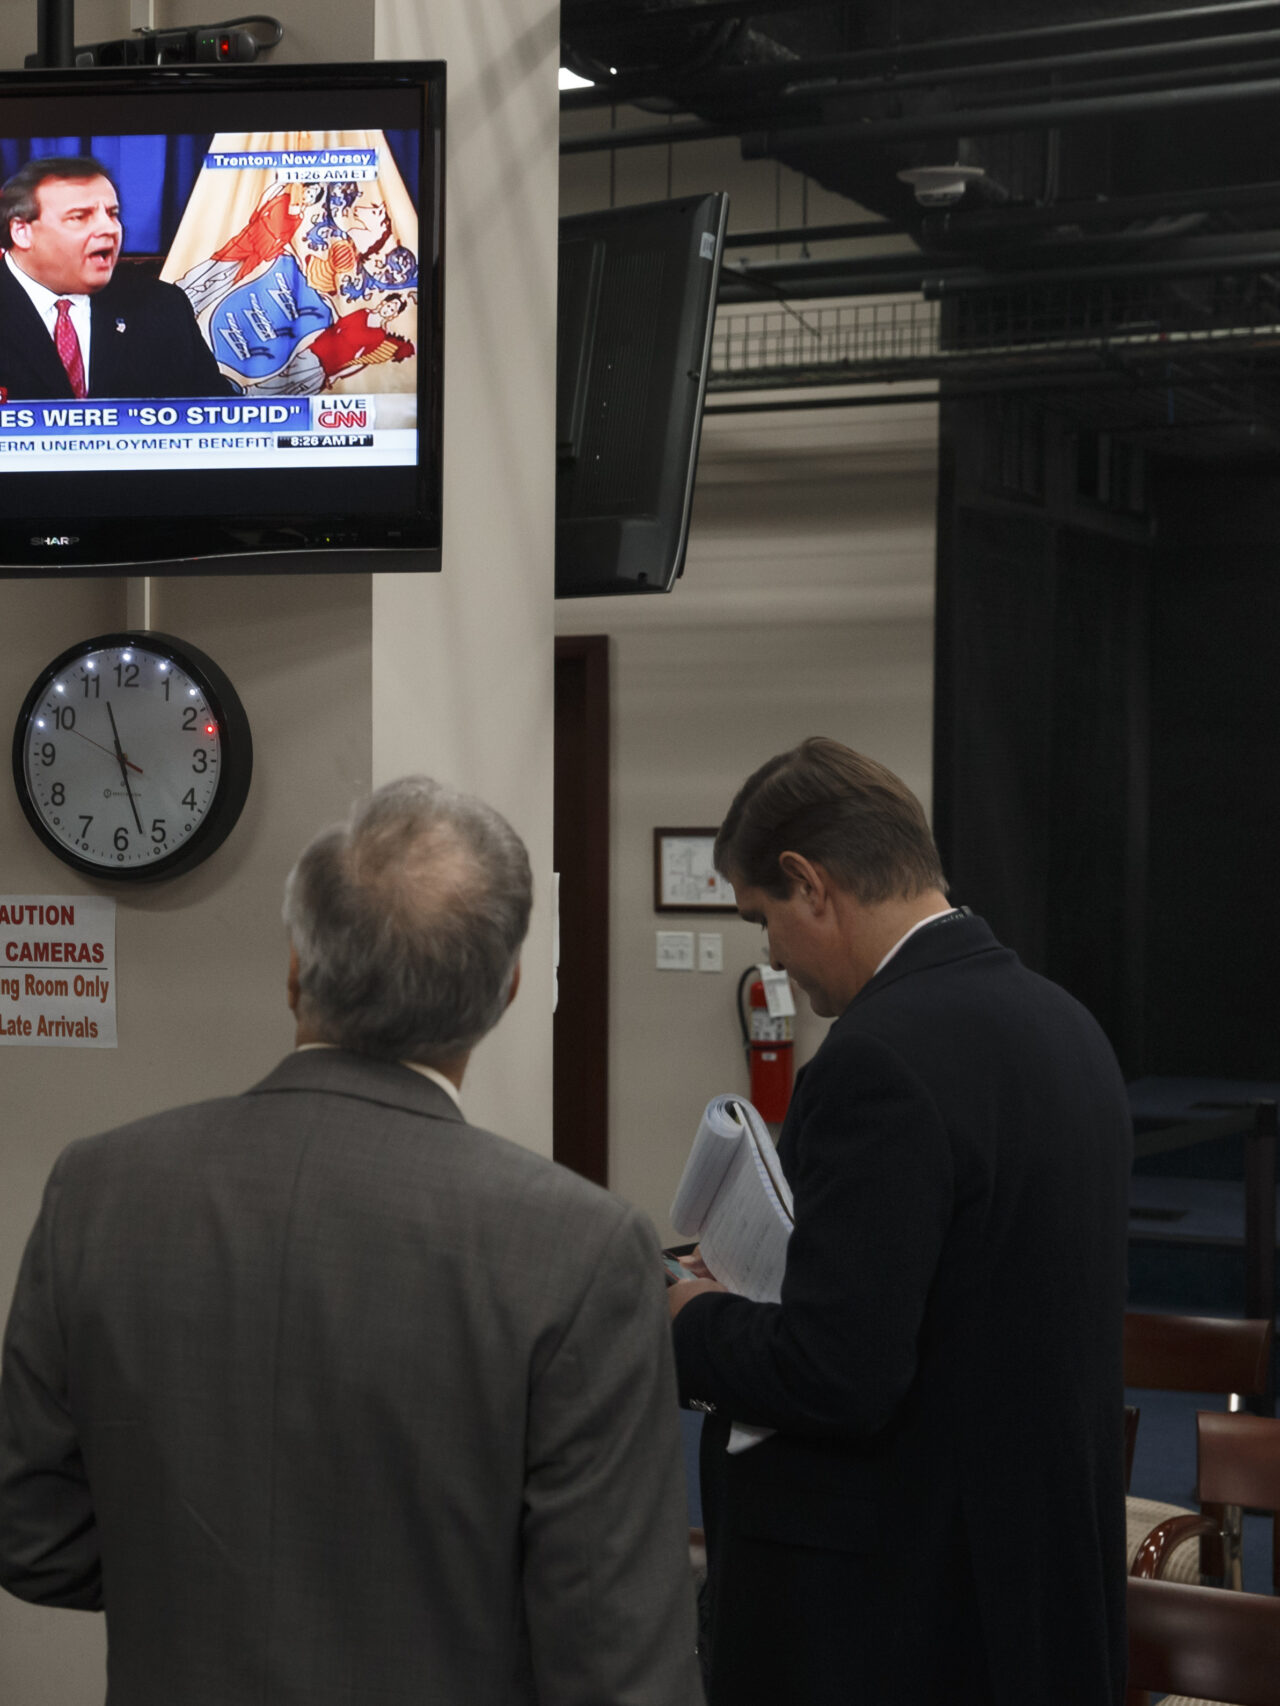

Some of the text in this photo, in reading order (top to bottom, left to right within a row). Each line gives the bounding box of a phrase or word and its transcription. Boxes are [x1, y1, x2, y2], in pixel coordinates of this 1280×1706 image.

[213, 152, 371, 167] Trenton, New Jersey
[286, 171, 320, 181] 11:26
[42, 409, 119, 427] WERE
[128, 407, 176, 426] "SO
[186, 405, 301, 425] STUPID"
[321, 399, 366, 410] LIVE
[318, 410, 367, 428] CNN
[41, 438, 193, 451] UNEMPLOYMENT
[199, 437, 273, 449] BENEFIT
[290, 434, 367, 447] 8:26 AM PT
[30, 536, 80, 546] SHARP
[81, 674, 100, 698] 11
[113, 663, 140, 688] 12
[161, 678, 170, 701] 1
[52, 706, 76, 731] 10
[182, 707, 198, 731] 2
[41, 742, 56, 767] 9
[192, 749, 208, 773] 3
[51, 782, 66, 807] 8
[182, 788, 198, 811] 4
[79, 815, 93, 839] 7
[113, 827, 129, 851] 6
[151, 819, 167, 843] 5
[5, 941, 105, 963] CAMERAS
[24, 973, 68, 997] Room
[73, 974, 109, 1003] Only
[36, 1014, 99, 1039] Arrivals
